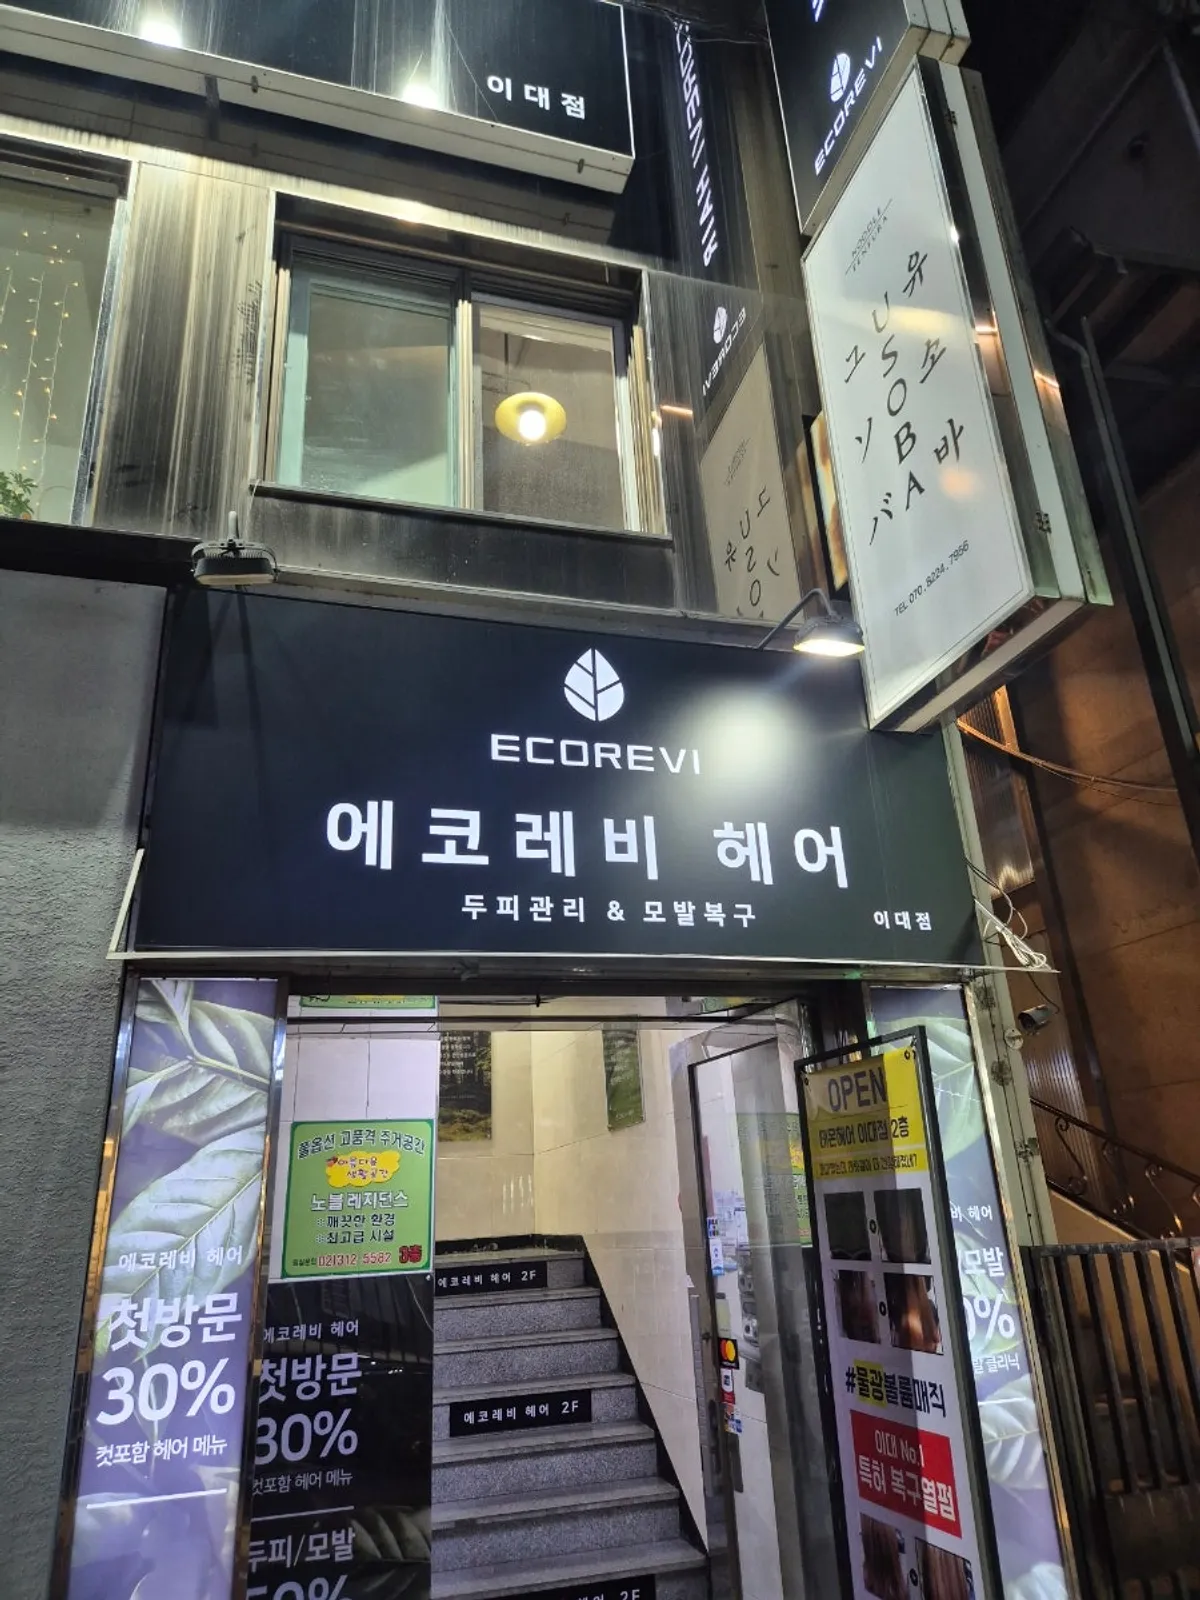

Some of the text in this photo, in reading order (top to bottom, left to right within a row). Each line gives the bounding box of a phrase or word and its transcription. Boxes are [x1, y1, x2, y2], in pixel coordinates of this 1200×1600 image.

[487, 75, 586, 120] 이대점
[814, 36, 882, 176] ECOREVI
[490, 733, 701, 775] ECOREVI
[326, 800, 849, 889] 에코레비 헤어
[462, 894, 755, 928] 두피관리 & 모발복구
[873, 910, 932, 931] 이대점
[828, 1066, 888, 1112] OPEN
[891, 1115, 909, 1138] 2층
[340, 1129, 376, 1147] 고품격
[380, 1131, 426, 1155] 주거공간
[371, 1213, 396, 1227] 환경
[967, 1205, 993, 1221] 헤어
[370, 1229, 395, 1243] 시설
[118, 1245, 243, 1273] 에코레비 헤어
[363, 1252, 392, 1264] 5582
[437, 1269, 537, 1288] 에코레비 헤어 2F
[110, 1292, 242, 1351] 첫방문
[330, 1319, 359, 1337] 헤어
[96, 1357, 236, 1426] 30%
[259, 1352, 362, 1404] 첫방문
[463, 1400, 579, 1424] 에코레비 헤어 2F
[255, 1408, 358, 1465] 30%
[875, 1429, 898, 1457] 이대
[96, 1434, 228, 1468] 컷포함 헤어 메뉴
[295, 1471, 322, 1491] 헤어
[326, 1469, 353, 1487] 메뉴
[858, 1455, 887, 1494] 특허
